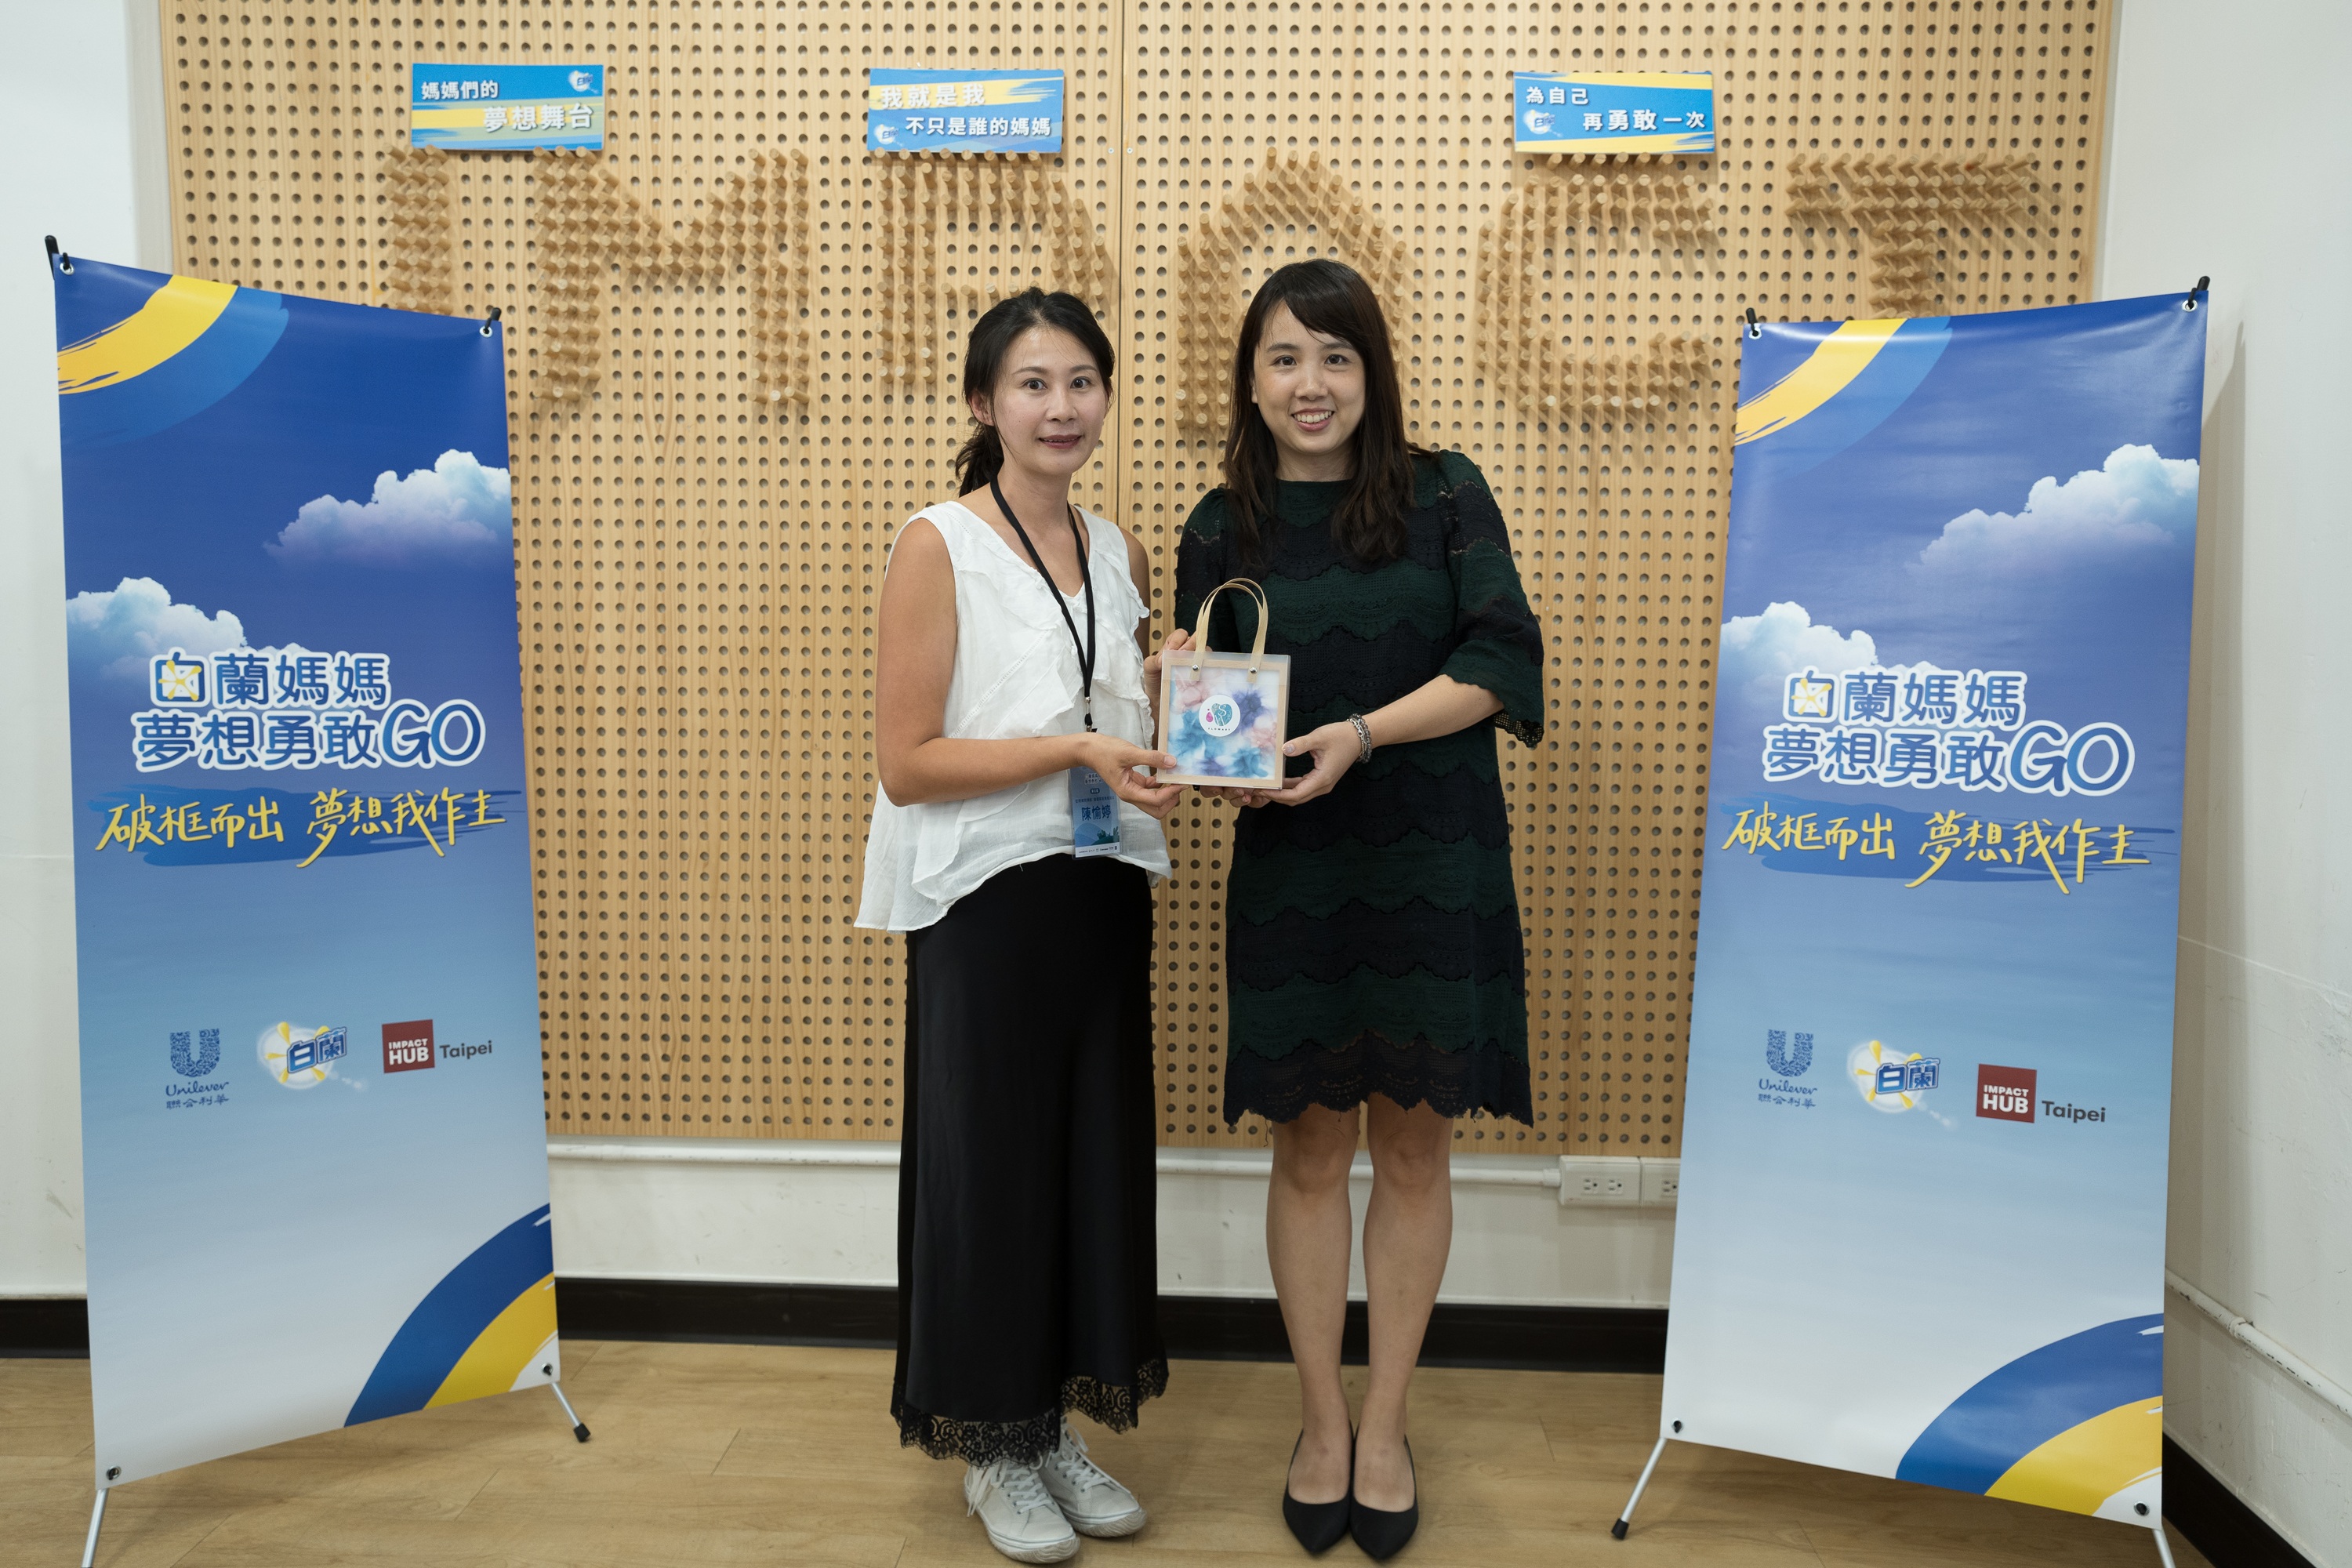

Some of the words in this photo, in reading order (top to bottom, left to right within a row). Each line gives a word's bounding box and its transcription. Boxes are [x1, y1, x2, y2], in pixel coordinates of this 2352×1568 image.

[421, 80, 499, 100] 媽媽們的
[880, 83, 985, 108] 我就是我
[1526, 86, 1588, 104] 為自己
[483, 103, 593, 132] 夢想舞台
[906, 116, 1051, 136] 不只是誰的媽媽
[1583, 109, 1705, 131] 再勇敢一次
[153, 651, 389, 706] 白蘭媽媽
[1785, 667, 2025, 727] 白蘭媽媽
[96, 793, 285, 852] 破框而出
[296, 786, 506, 868] 夢想我作主
[1722, 801, 1896, 861] 破框而出
[1904, 810, 2151, 895] 夢想我作主
[287, 1027, 347, 1073] 白蘭
[389, 1038, 429, 1051] IMPACT
[440, 1040, 493, 1059] Taipei
[389, 1046, 430, 1065] HUB
[1759, 1079, 1817, 1094] Unilever
[1875, 1058, 1940, 1094] 白蘭
[165, 1081, 229, 1096] Unilever
[1983, 1085, 2029, 1098] IMPACT
[1982, 1094, 2029, 1114] HUB
[2042, 1100, 2106, 1123] Taipei
